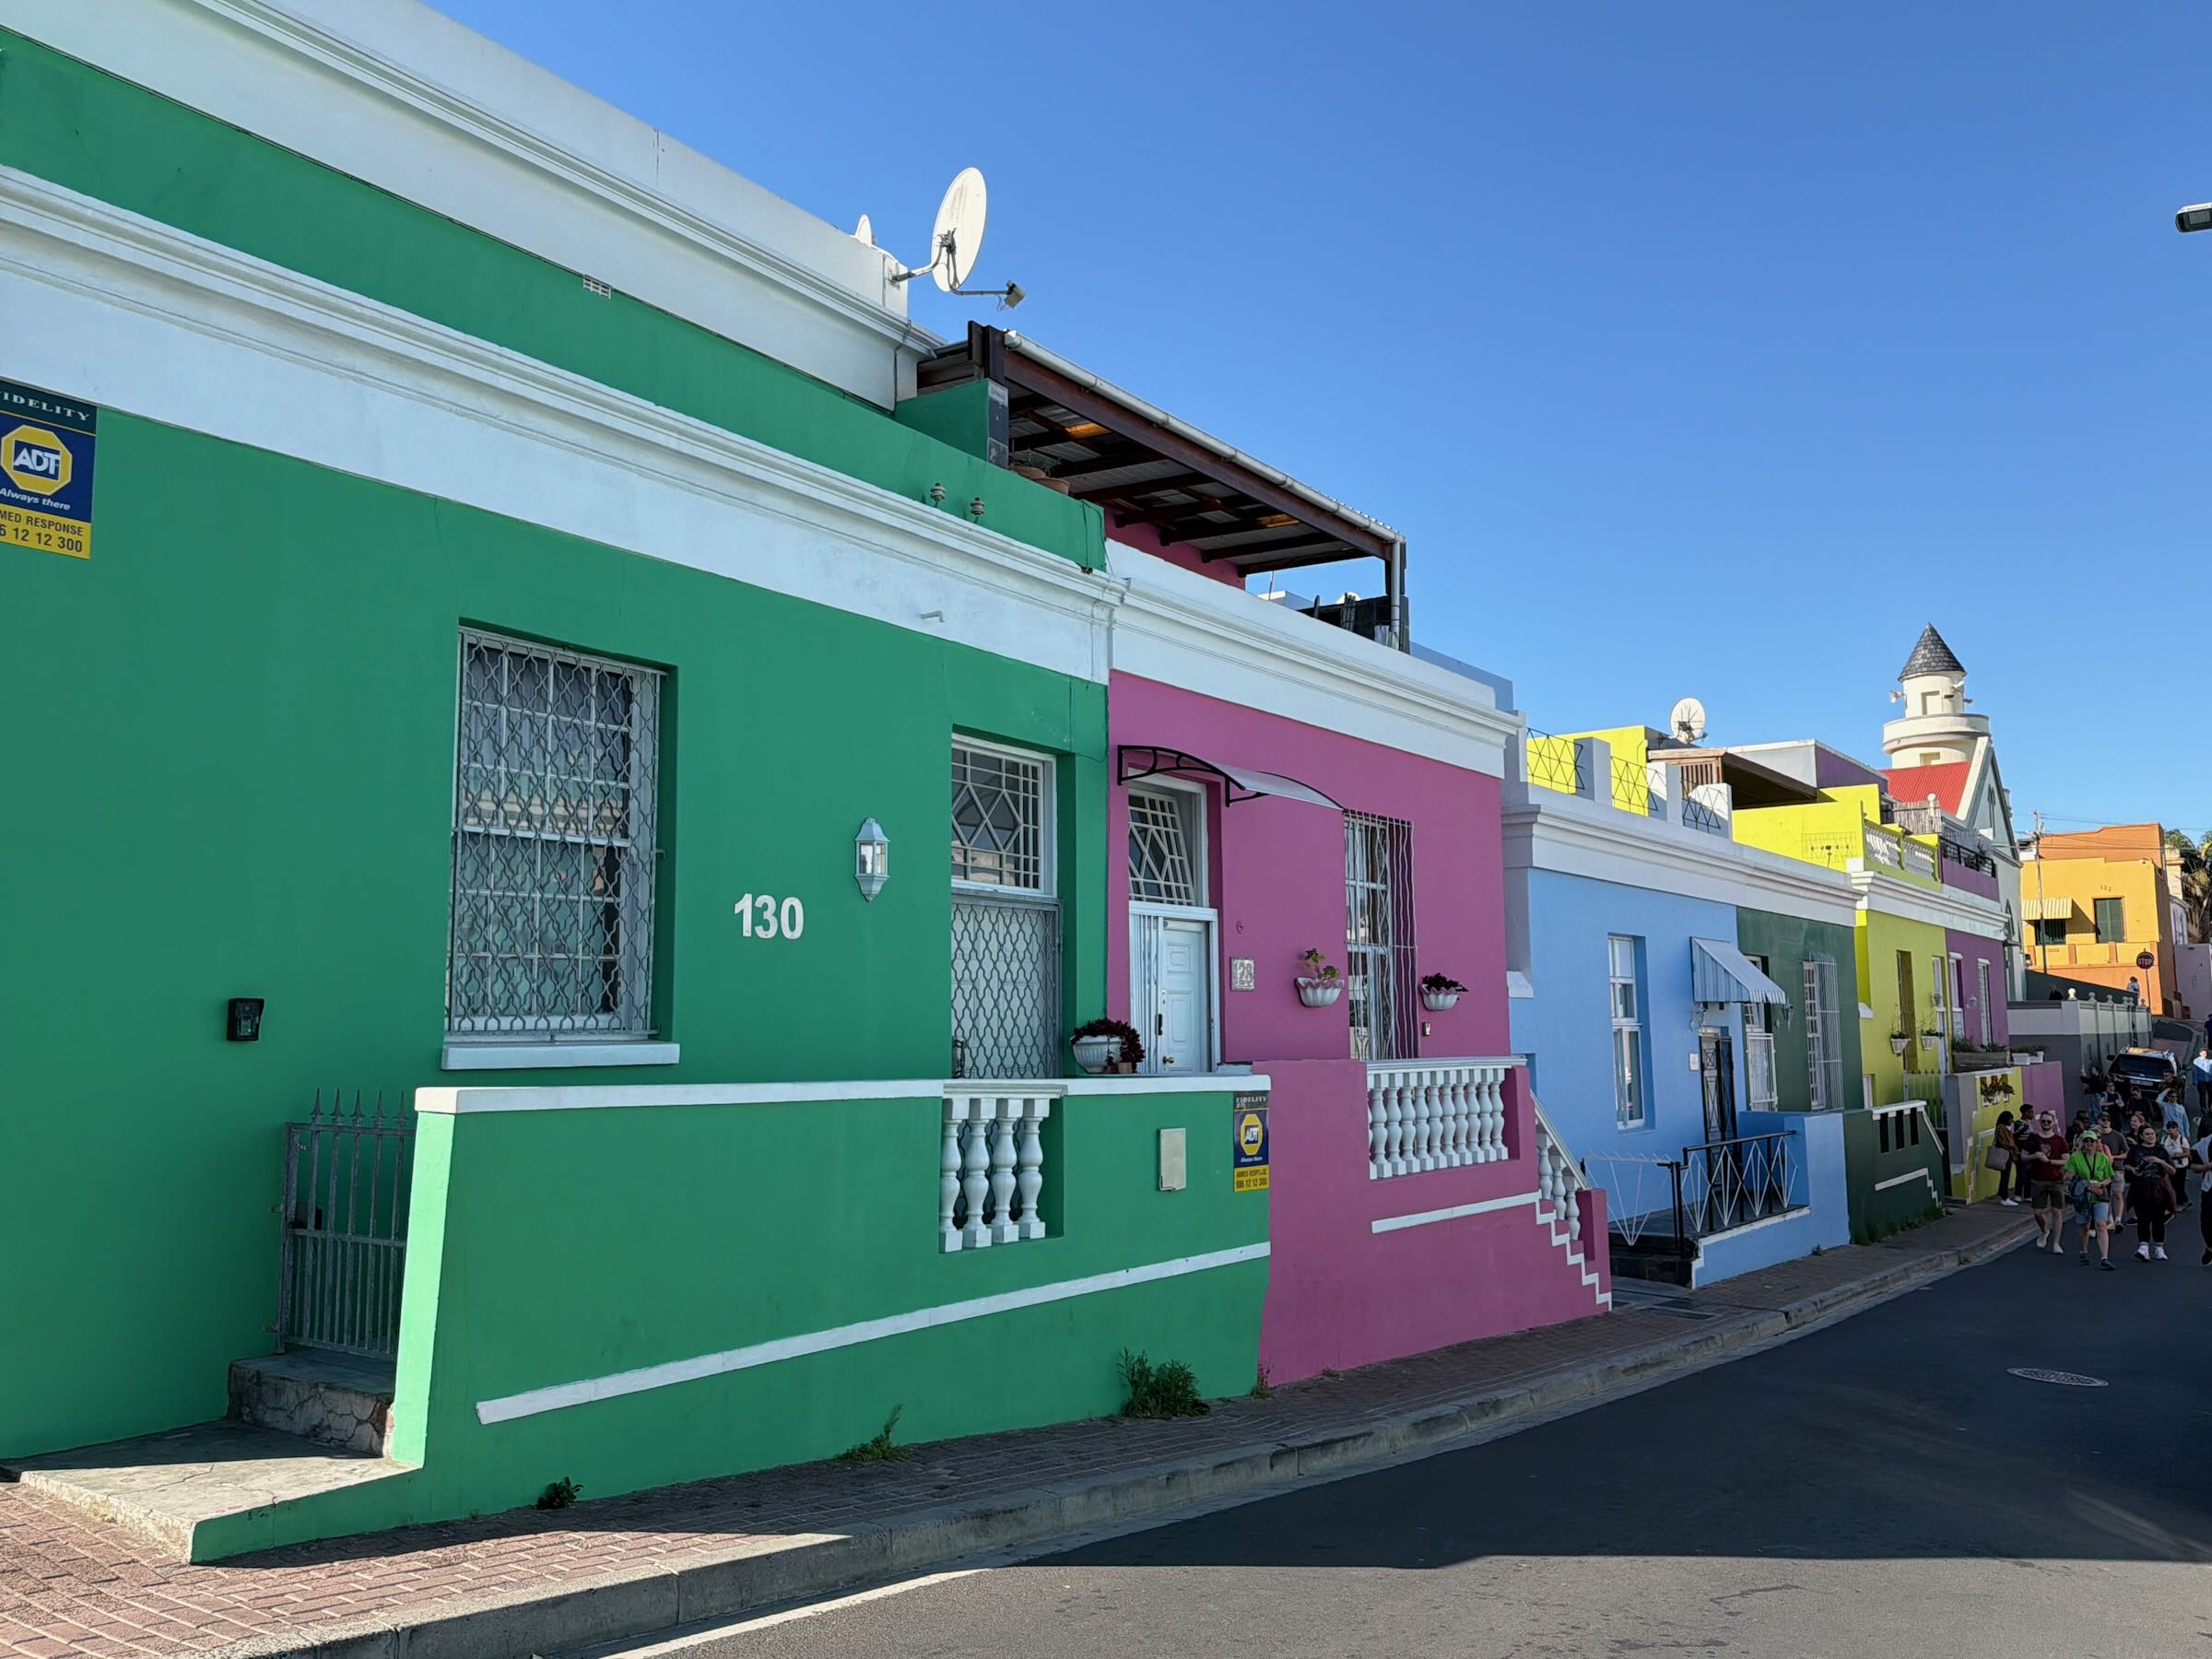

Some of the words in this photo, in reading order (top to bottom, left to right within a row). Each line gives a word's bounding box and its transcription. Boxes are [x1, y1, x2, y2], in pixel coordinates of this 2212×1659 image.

[0, 391, 90, 421] IDELITY
[13, 447, 61, 475] ADT
[0, 488, 40, 503] Always
[41, 498, 71, 511] there
[26, 516, 84, 536] RESPONSE
[13, 526, 29, 542] 12
[36, 532, 53, 547] 12
[57, 535, 83, 553] 300
[734, 892, 805, 940] 130
[1233, 961, 1253, 984] 128
[1245, 1127, 1259, 1142] ADT
